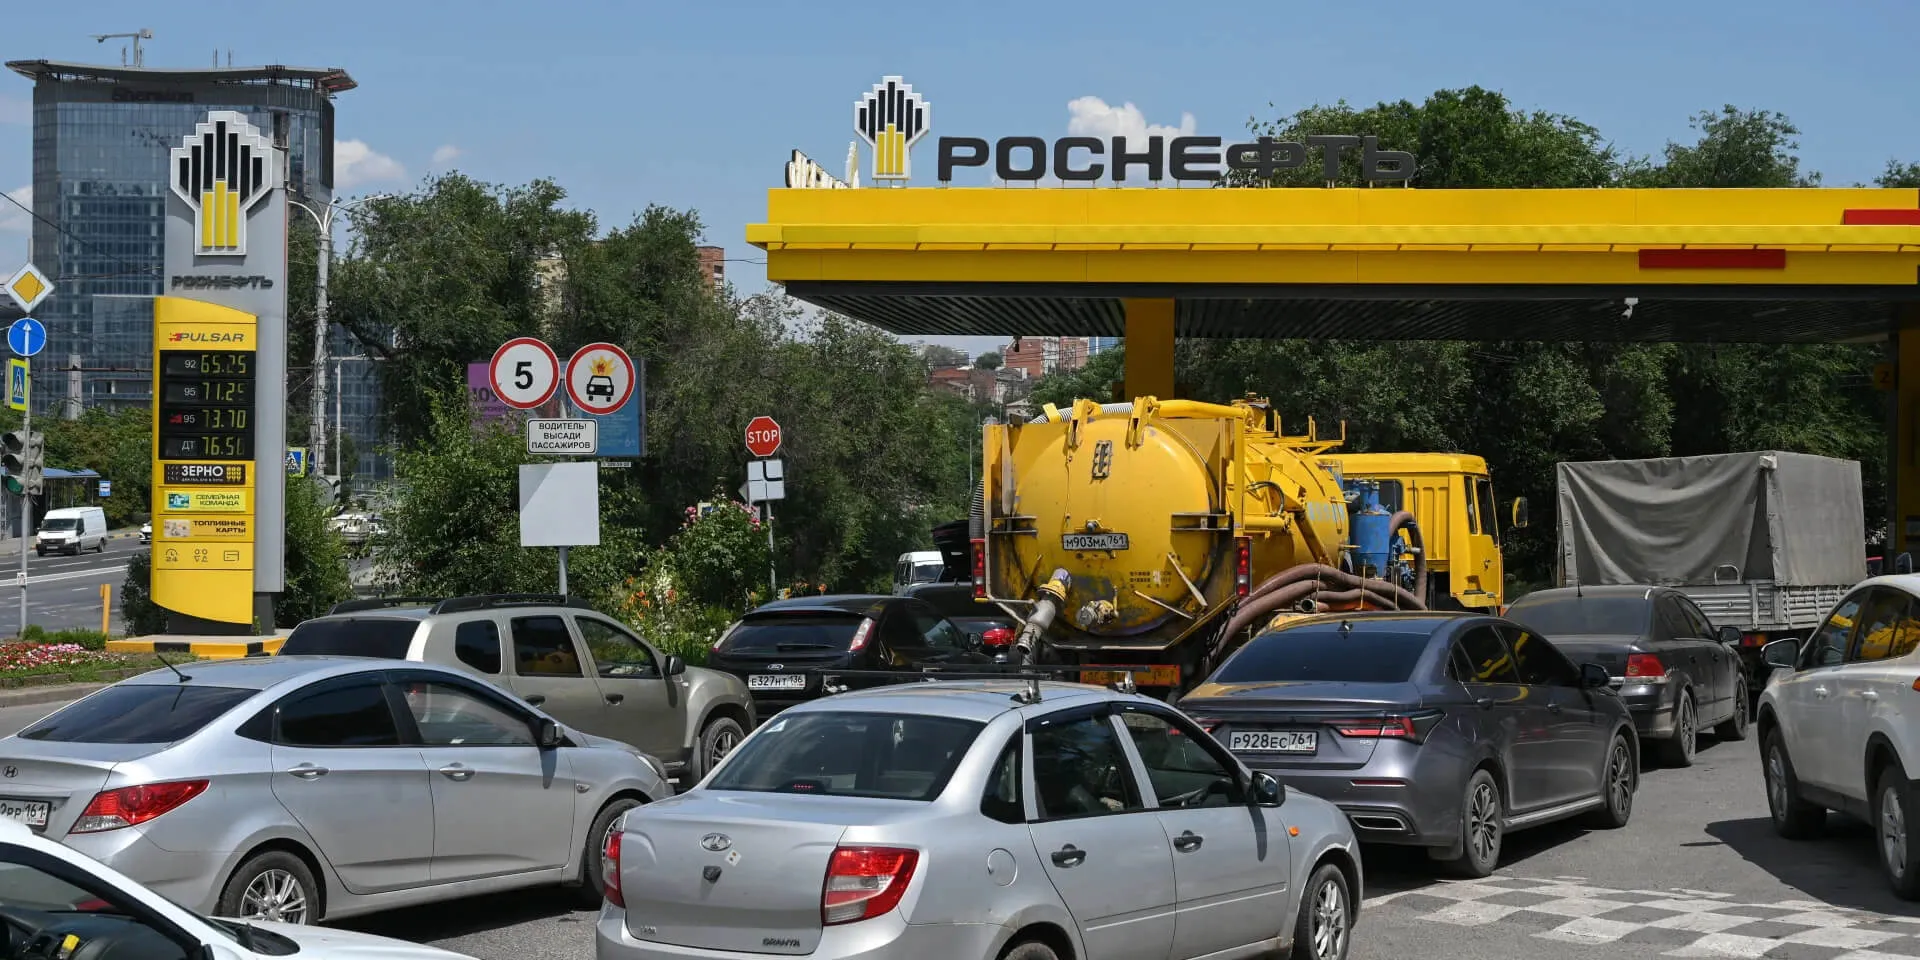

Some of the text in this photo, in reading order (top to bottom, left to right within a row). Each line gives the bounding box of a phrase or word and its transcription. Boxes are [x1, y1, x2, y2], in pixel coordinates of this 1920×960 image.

[938, 135, 1416, 182] РОСНЕФТЬ
[171, 275, 273, 290] РОСНЕФТЬ
[180, 333, 244, 342] PULSAR
[184, 360, 196, 369] 92
[514, 361, 534, 390] 5
[184, 387, 196, 396] 95
[183, 409, 247, 429] 95 73.70
[538, 422, 587, 431] ВОДИТЕЛЬ!
[543, 432, 581, 441] ВЫСАДИ
[747, 429, 778, 444] STOP
[181, 441, 196, 450] ДТ
[531, 441, 591, 449] ПАССАЖИРОВ
[181, 465, 224, 477] ЗЕРНО
[1066, 535, 1124, 548] М903МА 761
[751, 675, 787, 687] Е327НТ
[1234, 733, 1313, 748] Р928ЕС 761
[25, 803, 45, 819] 161
